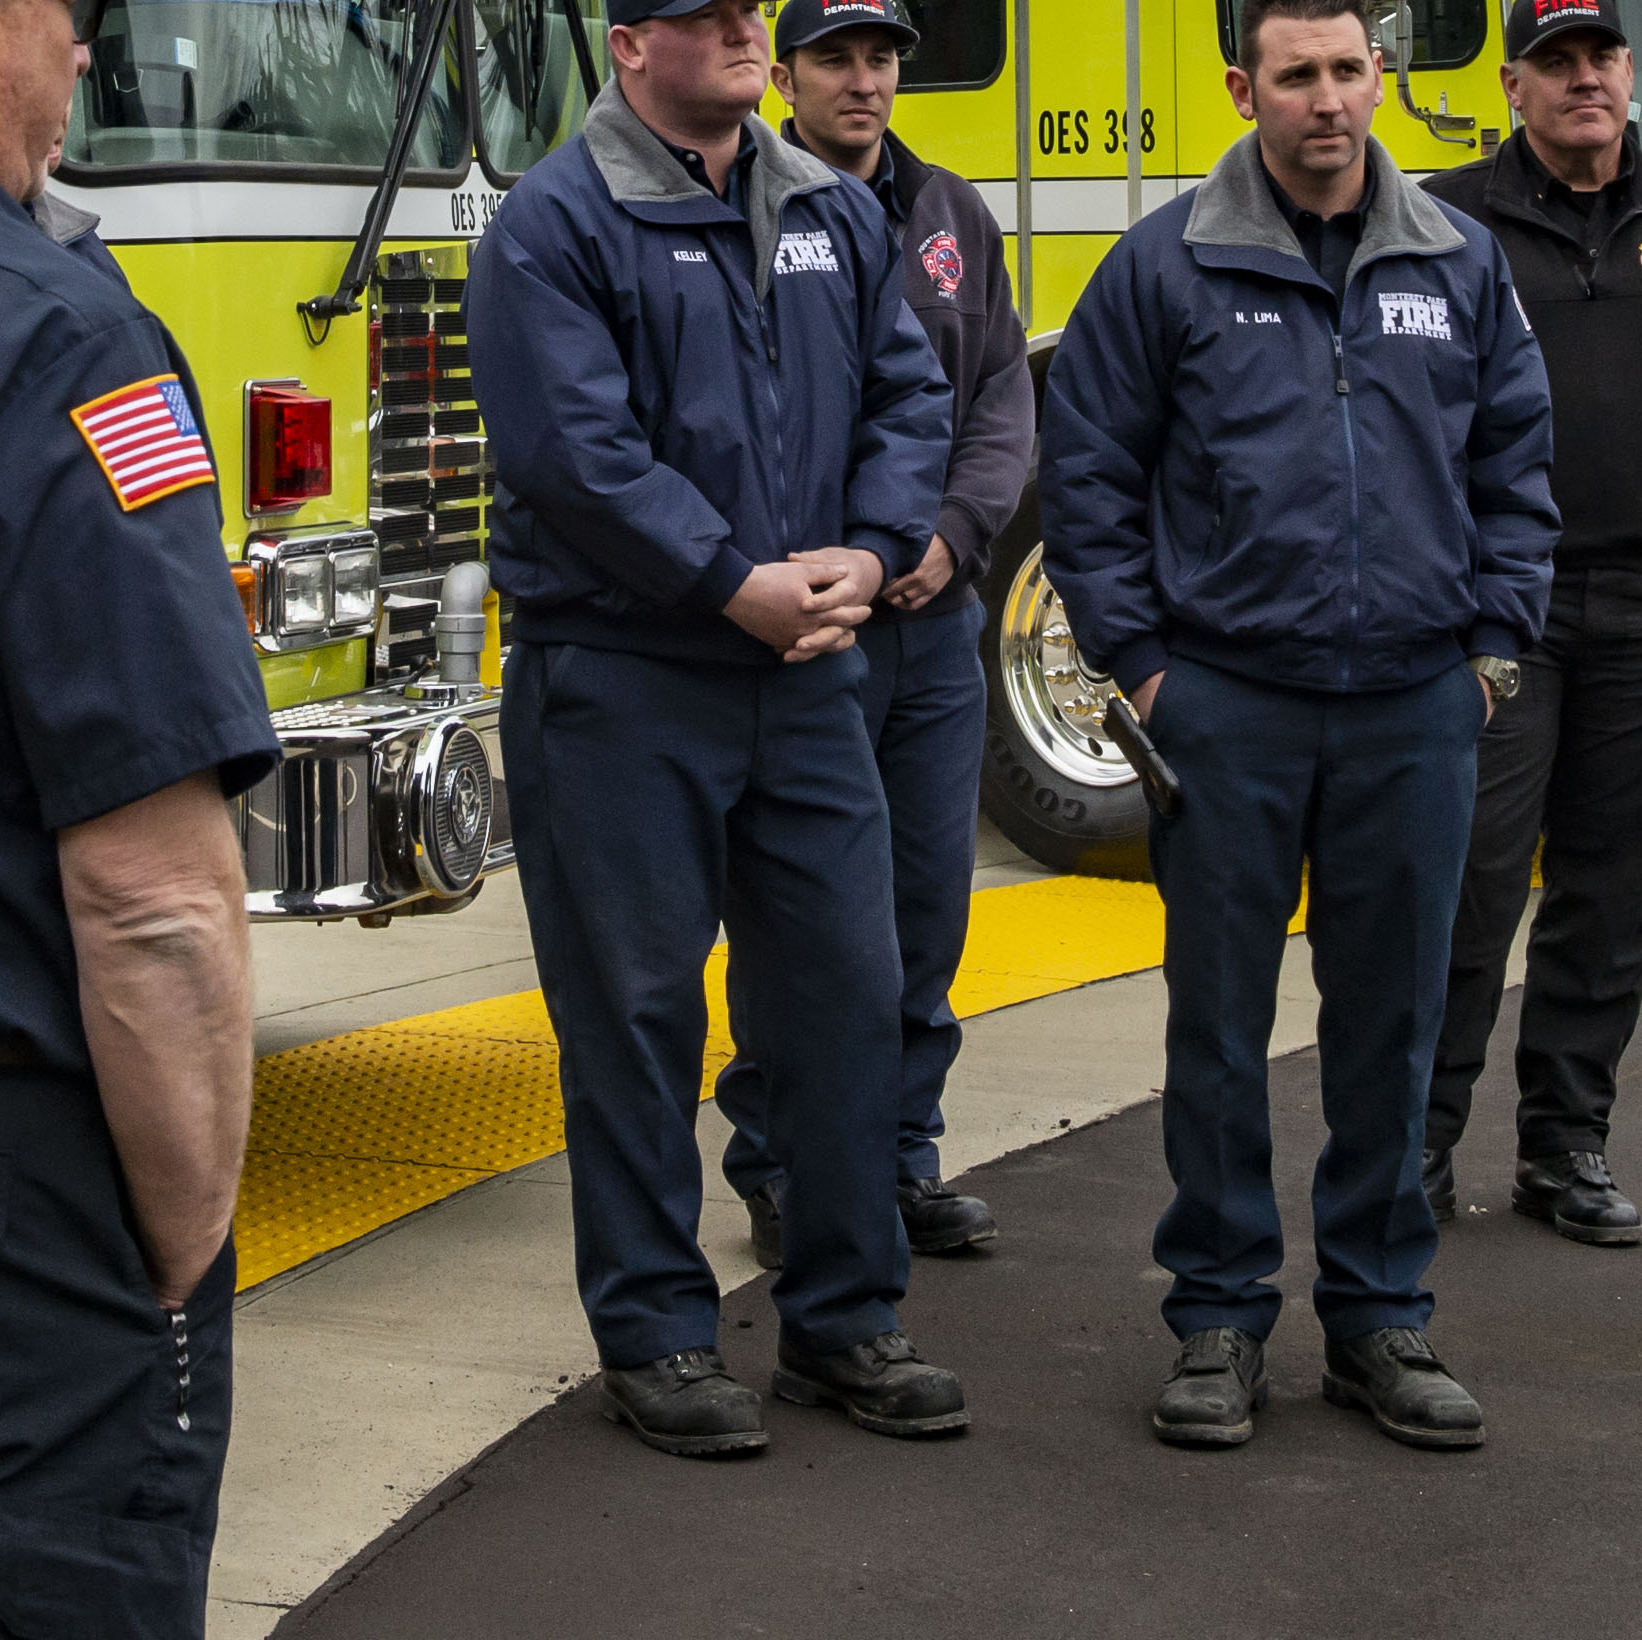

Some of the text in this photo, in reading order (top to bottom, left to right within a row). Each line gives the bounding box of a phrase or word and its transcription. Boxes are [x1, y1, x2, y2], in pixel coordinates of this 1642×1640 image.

[823, 3, 885, 17] DEPARTMENT
[1537, 7, 1600, 26] DEPARTMENT
[1038, 109, 1089, 155] OES
[451, 192, 475, 231] OES
[673, 250, 707, 262] KELLEY
[774, 238, 838, 268] FIRE
[776, 263, 839, 275] DEPARTMENT
[1378, 292, 1448, 305] MONTEREY PARK
[1235, 311, 1282, 324] N. LIMA
[1379, 300, 1451, 333] FIRE
[1383, 327, 1452, 341] DEPARTMENT
